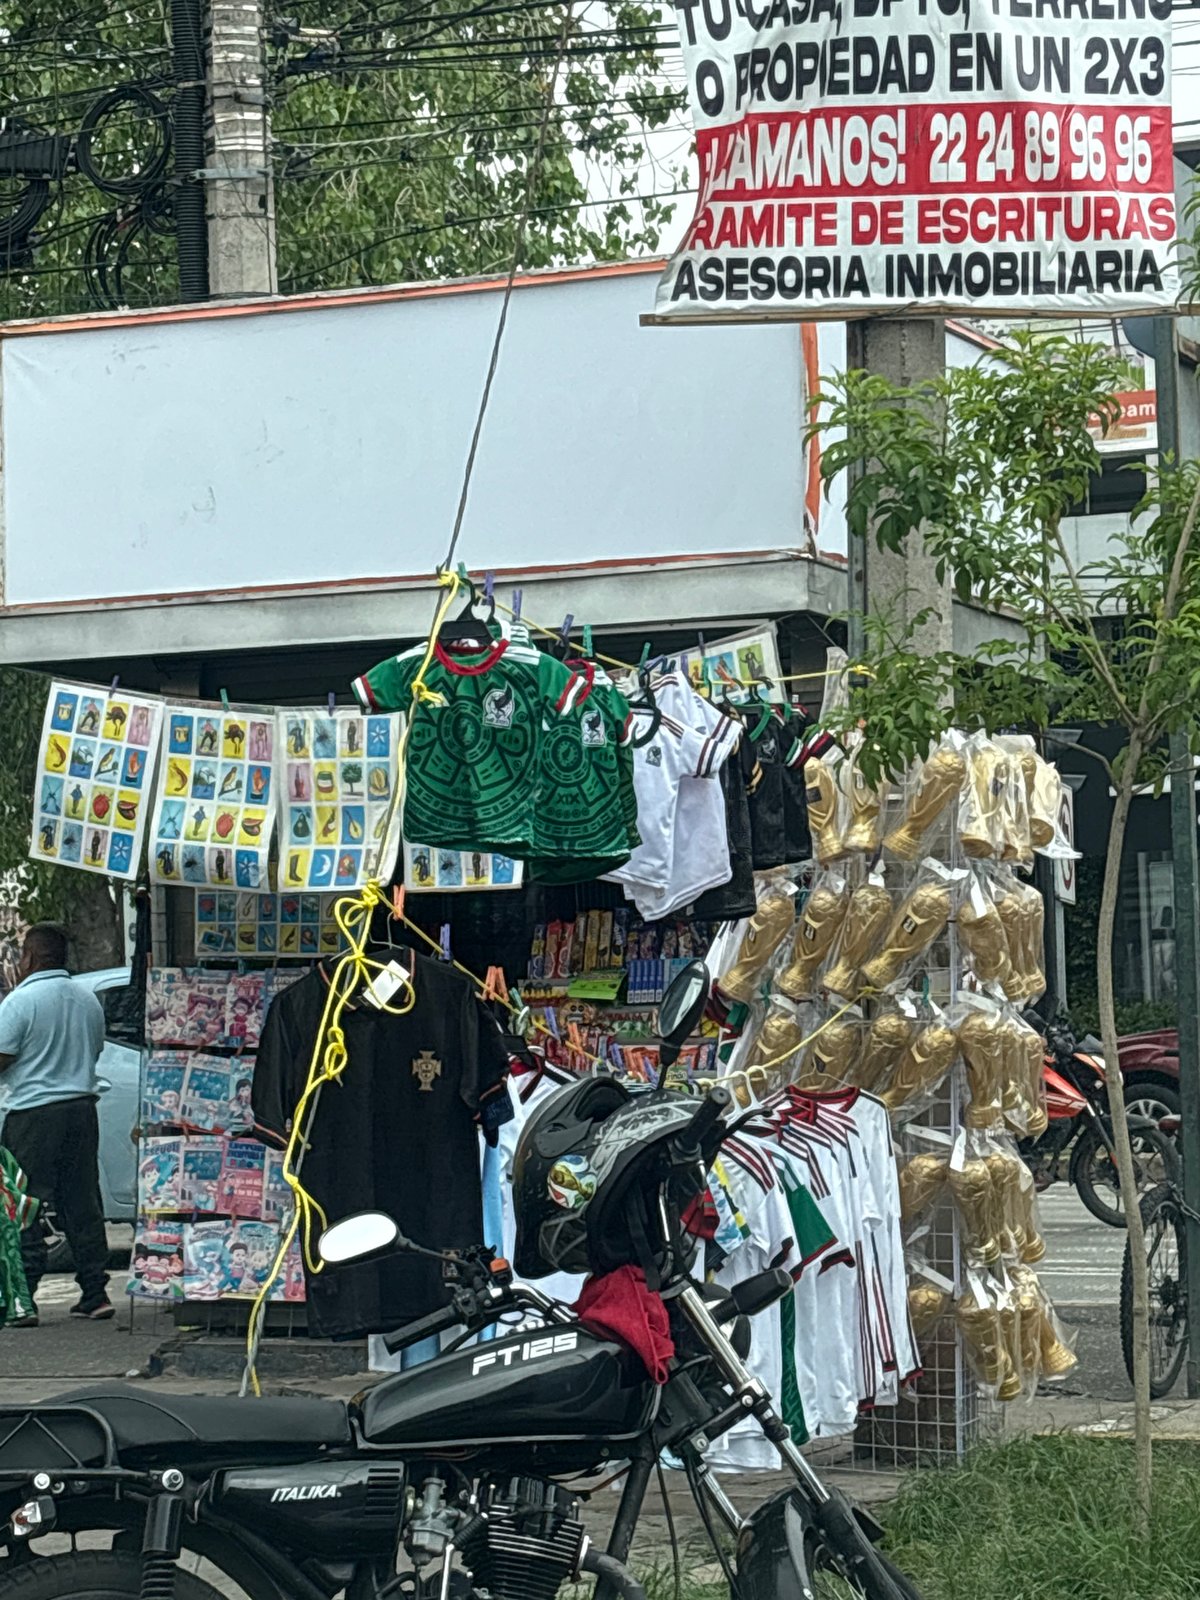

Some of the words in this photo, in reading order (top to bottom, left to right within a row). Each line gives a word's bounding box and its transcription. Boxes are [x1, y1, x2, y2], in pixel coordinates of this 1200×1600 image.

[675, 0, 732, 45] TU
[695, 59, 725, 118] O
[733, 35, 935, 112] PROPIEDAD
[949, 33, 1003, 92] EN
[1015, 35, 1070, 94] UN
[1084, 36, 1165, 96] 2X3
[929, 112, 967, 183] 22
[976, 111, 1015, 182] 24
[1024, 110, 1061, 183] 89
[1069, 112, 1107, 182] 96
[1114, 114, 1152, 184] 96
[682, 202, 838, 251] RAMITE
[851, 200, 904, 247] DE
[917, 196, 1176, 244] ESCRITURAS
[669, 255, 871, 302] ASESORIA
[885, 249, 1165, 299] INMOBILIARIA
[472, 1332, 578, 1376] FT125
[270, 1484, 338, 1503] ITALIKA
